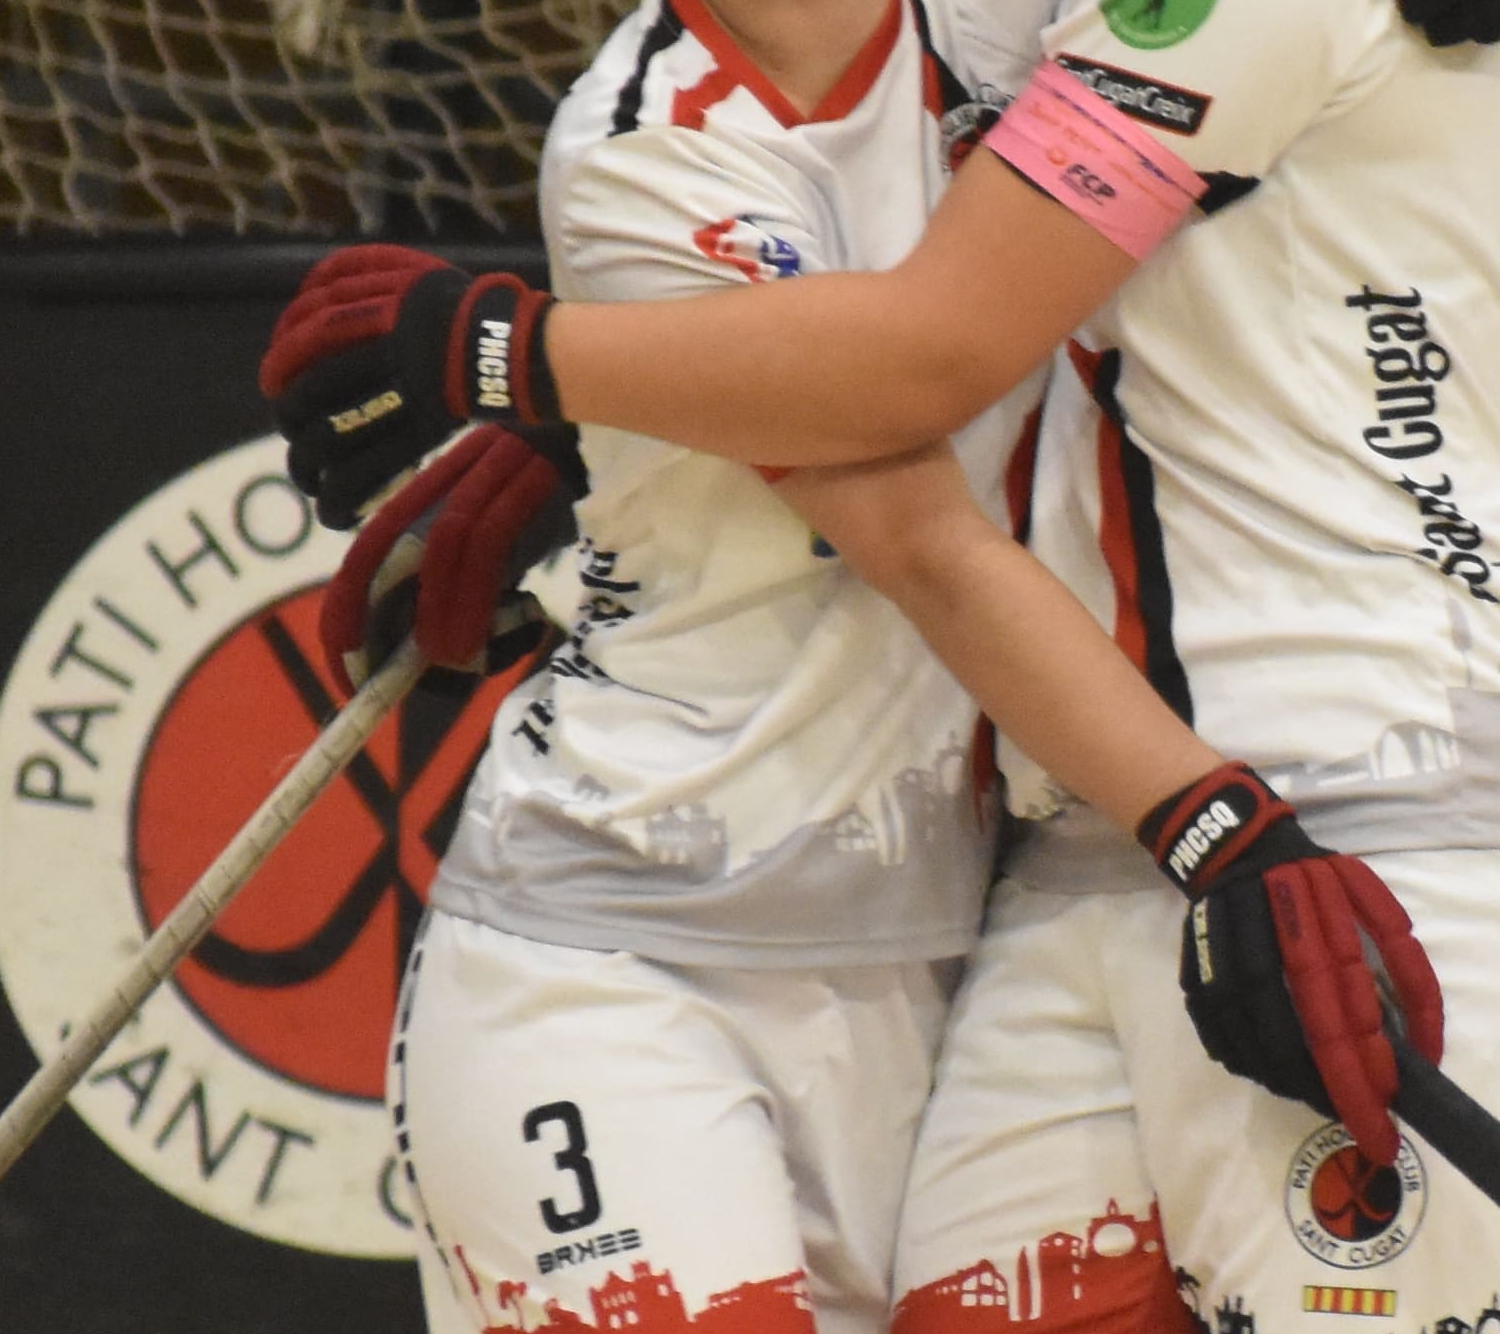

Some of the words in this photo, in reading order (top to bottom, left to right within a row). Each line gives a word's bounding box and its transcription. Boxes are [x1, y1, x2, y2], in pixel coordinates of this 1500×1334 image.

[1344, 284, 1451, 460] Cugat
[15, 596, 161, 810] PATI
[145, 473, 313, 610] HO
[62, 1019, 315, 1208] ANT
[523, 1100, 601, 1234] 3
